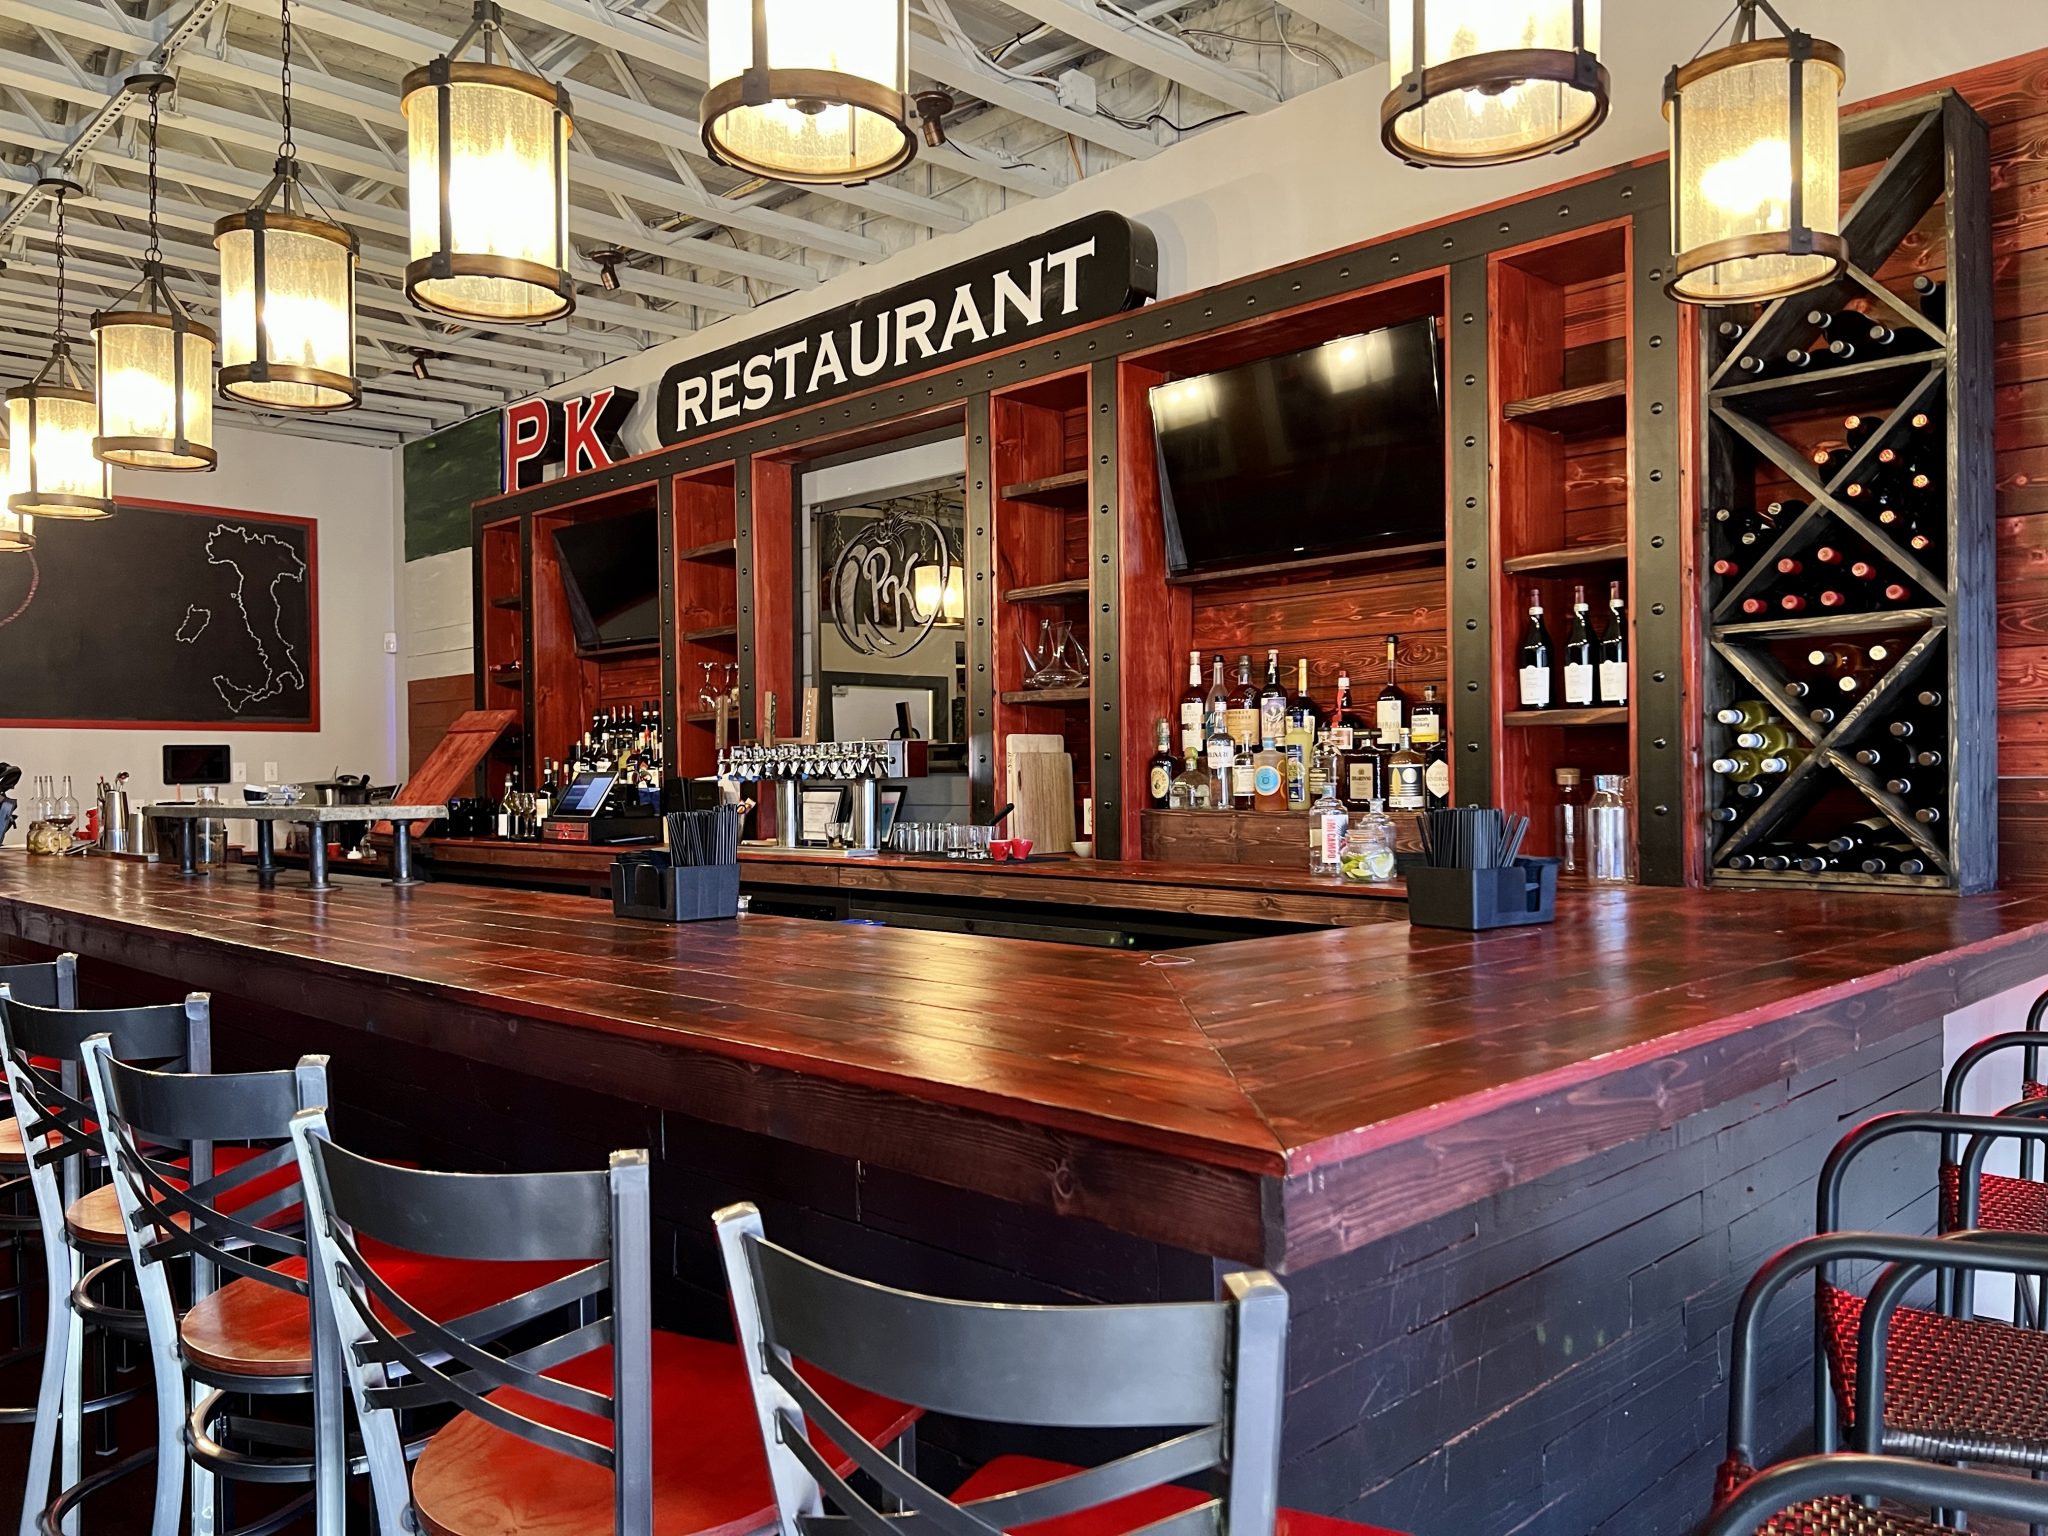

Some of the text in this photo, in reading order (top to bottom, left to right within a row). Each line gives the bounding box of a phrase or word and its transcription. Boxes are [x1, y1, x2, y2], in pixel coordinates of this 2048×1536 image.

[675, 235, 1096, 433] RESTAURANT
[804, 709, 812, 736] CASA
[1327, 833, 1337, 859] CAMPO
